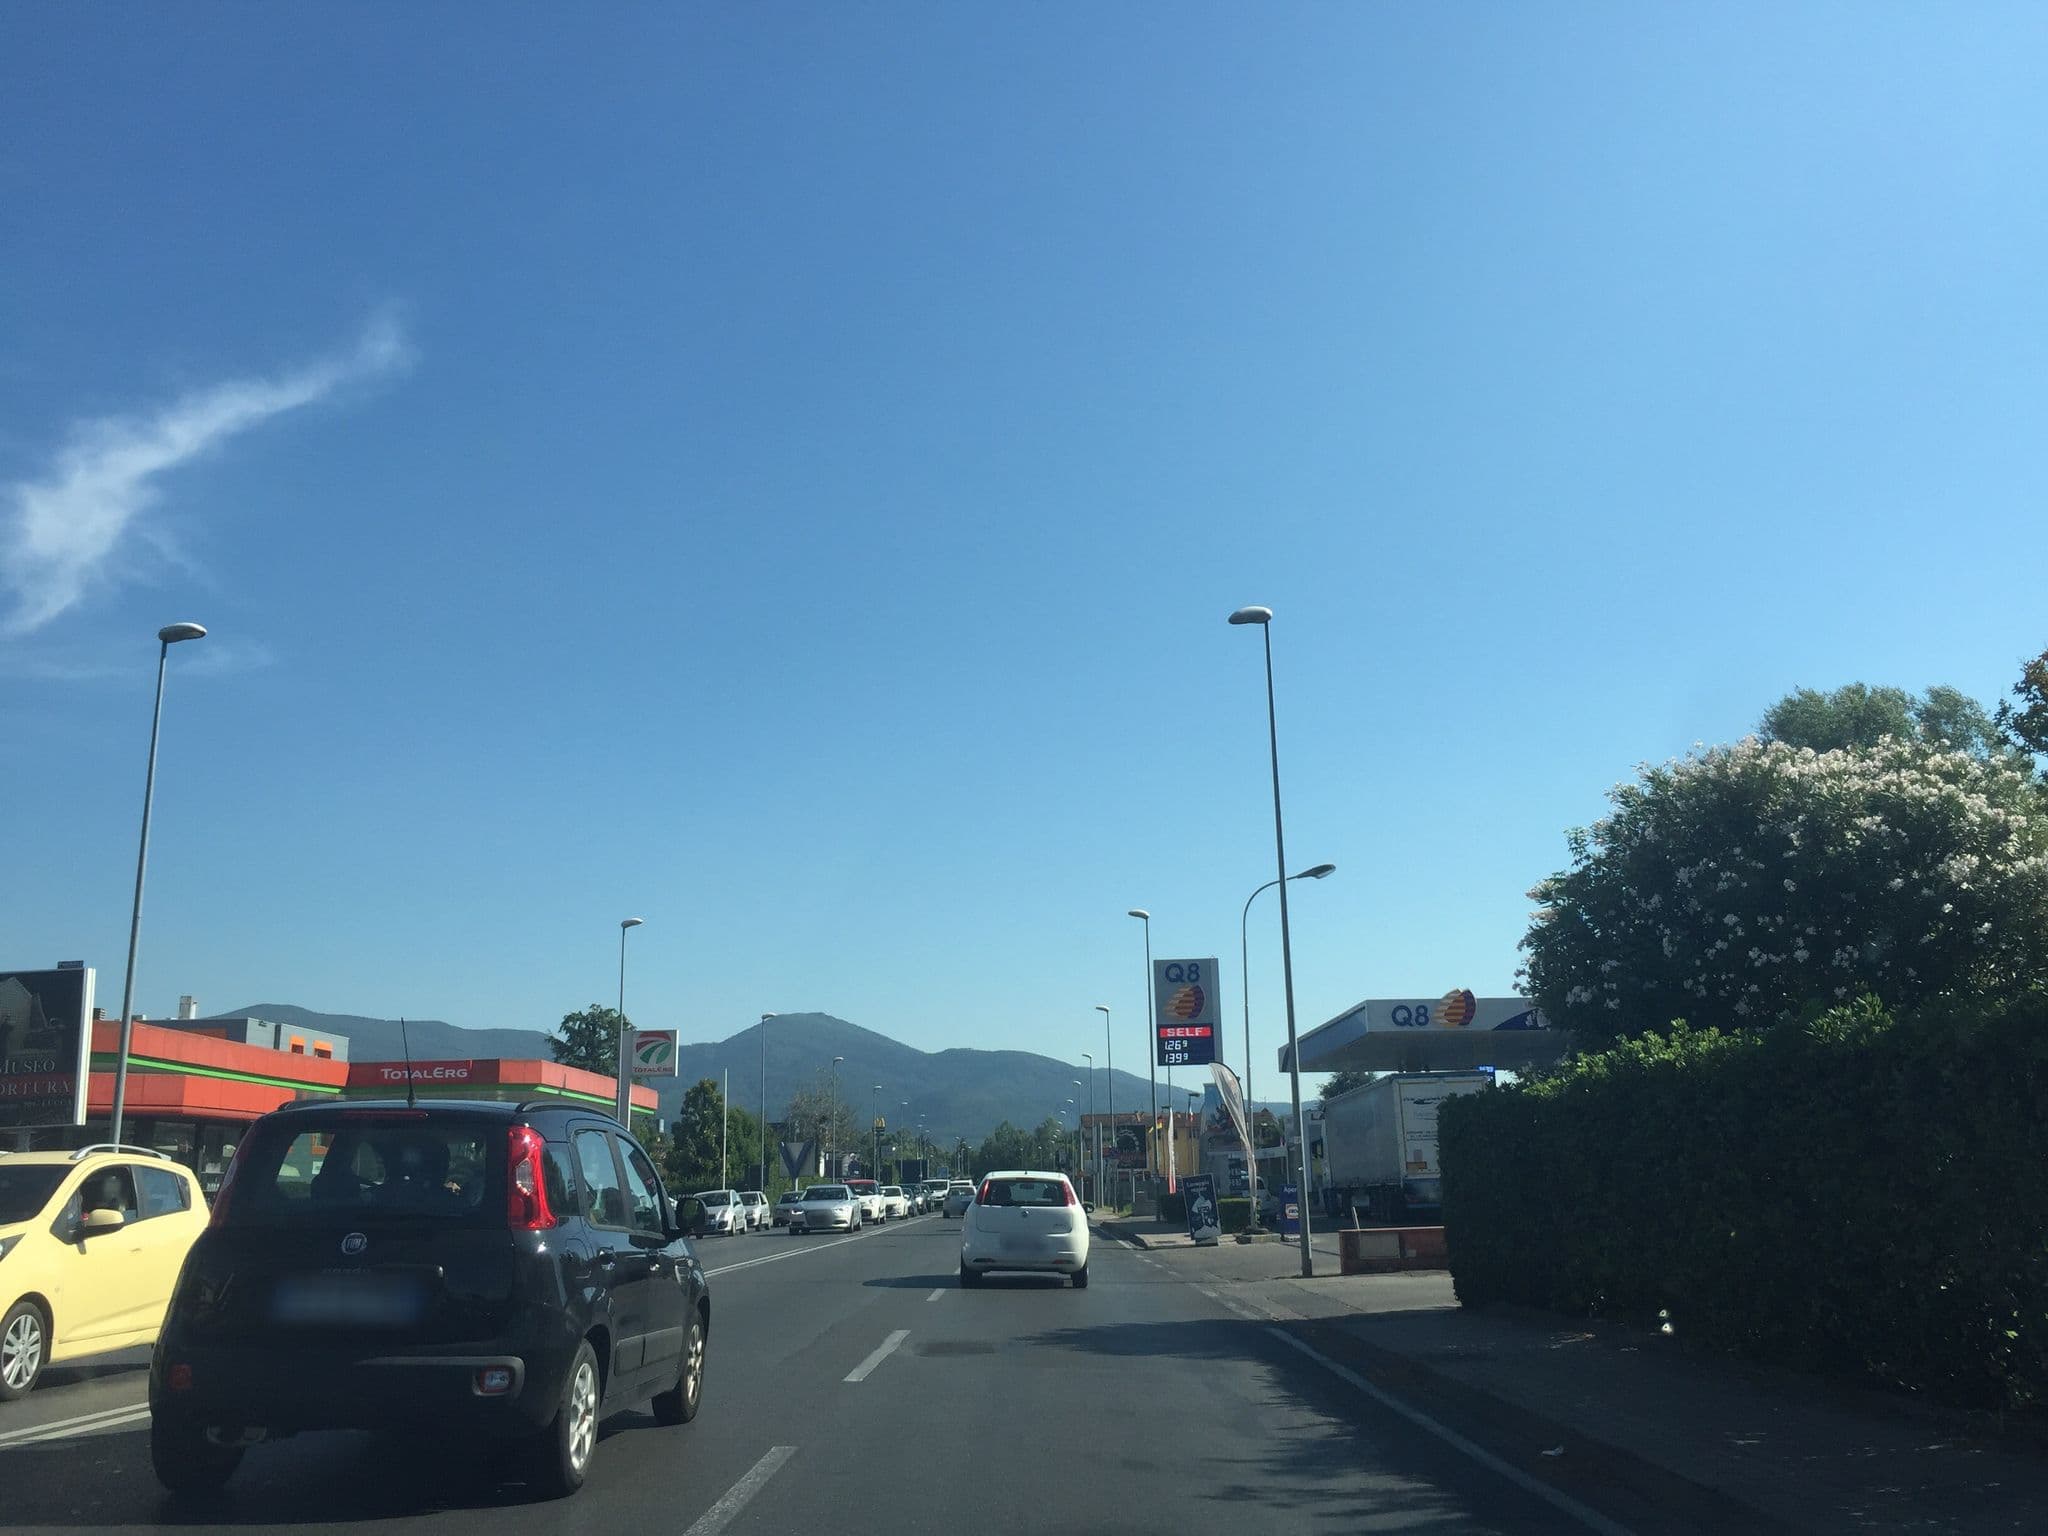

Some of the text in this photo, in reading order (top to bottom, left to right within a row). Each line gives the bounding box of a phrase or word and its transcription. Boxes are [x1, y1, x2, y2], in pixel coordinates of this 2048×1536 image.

[1165, 963, 1200, 982] Q8
[1392, 1005, 1429, 1027] Q8
[1167, 1027, 1203, 1037] SELF
